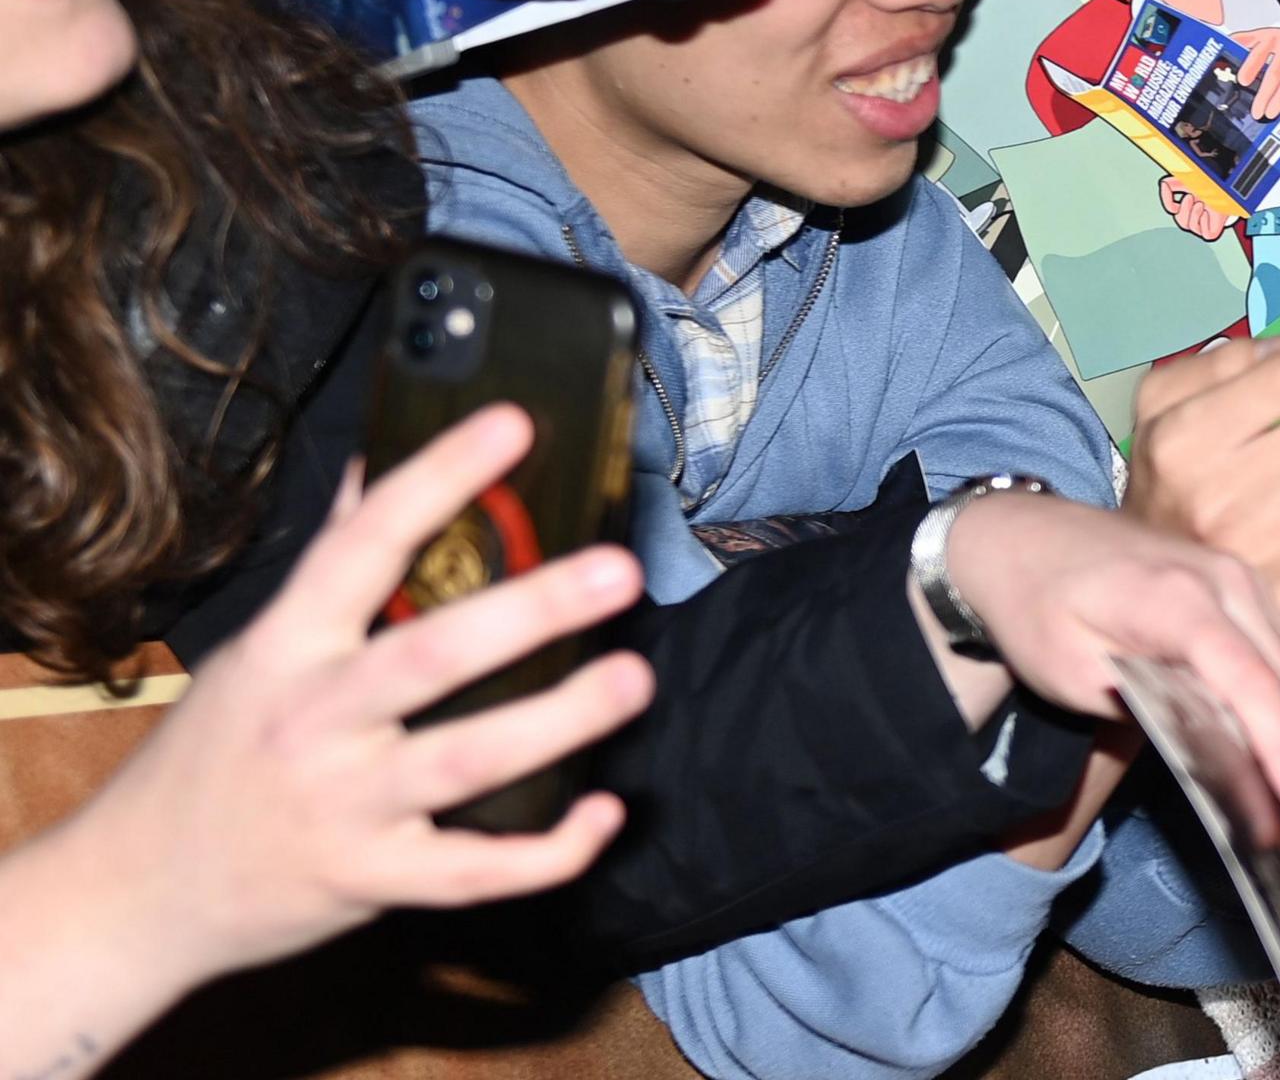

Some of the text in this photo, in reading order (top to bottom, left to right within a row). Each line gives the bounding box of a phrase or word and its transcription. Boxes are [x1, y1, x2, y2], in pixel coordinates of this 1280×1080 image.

[1109, 70, 1129, 92] MY
[1147, 44, 1199, 120] MAGAZINES AND
[1158, 100, 1183, 129] YOUR
